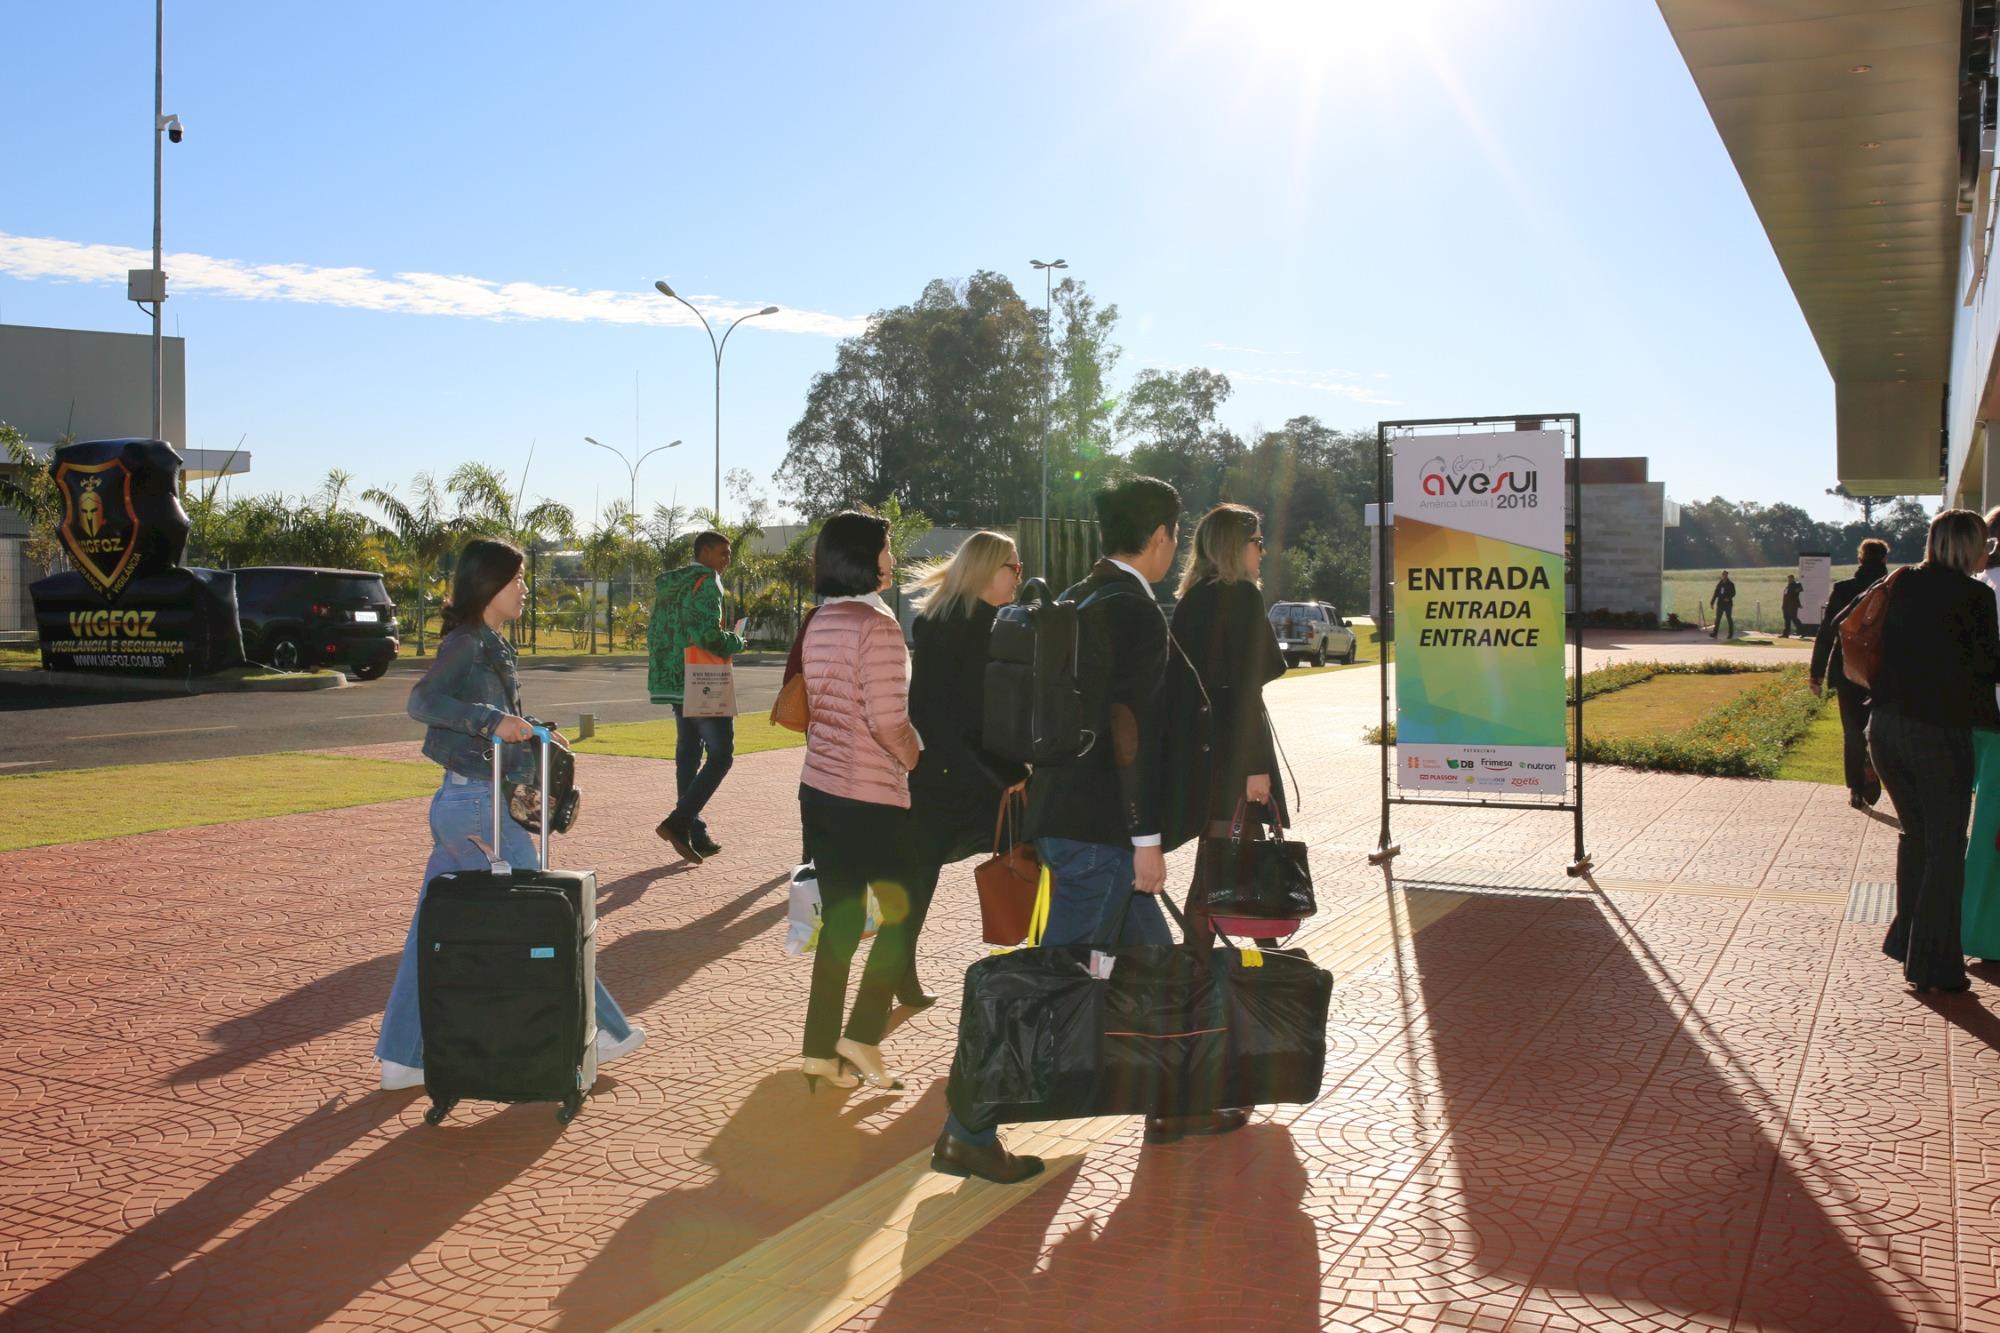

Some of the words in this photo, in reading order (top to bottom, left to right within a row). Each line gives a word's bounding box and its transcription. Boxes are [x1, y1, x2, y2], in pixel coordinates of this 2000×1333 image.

[1460, 497, 1488, 508] Latina
[1496, 494, 1538, 509] 2018
[1408, 566, 1551, 591] ENTRADA
[1425, 600, 1532, 619] ENTRADA
[69, 610, 157, 638] VIGFOZ
[1420, 628, 1540, 647] ENTRANCE
[52, 640, 108, 653] VIGILÂNCIA
[111, 640, 119, 652] E
[120, 640, 184, 656] SEGURANÇA
[73, 655, 165, 668] WWW.VIGFOZ.COM.BR
[1460, 760, 1474, 769] DB
[1481, 758, 1513, 767] Frimesa
[1511, 777, 1539, 786] zoetis
